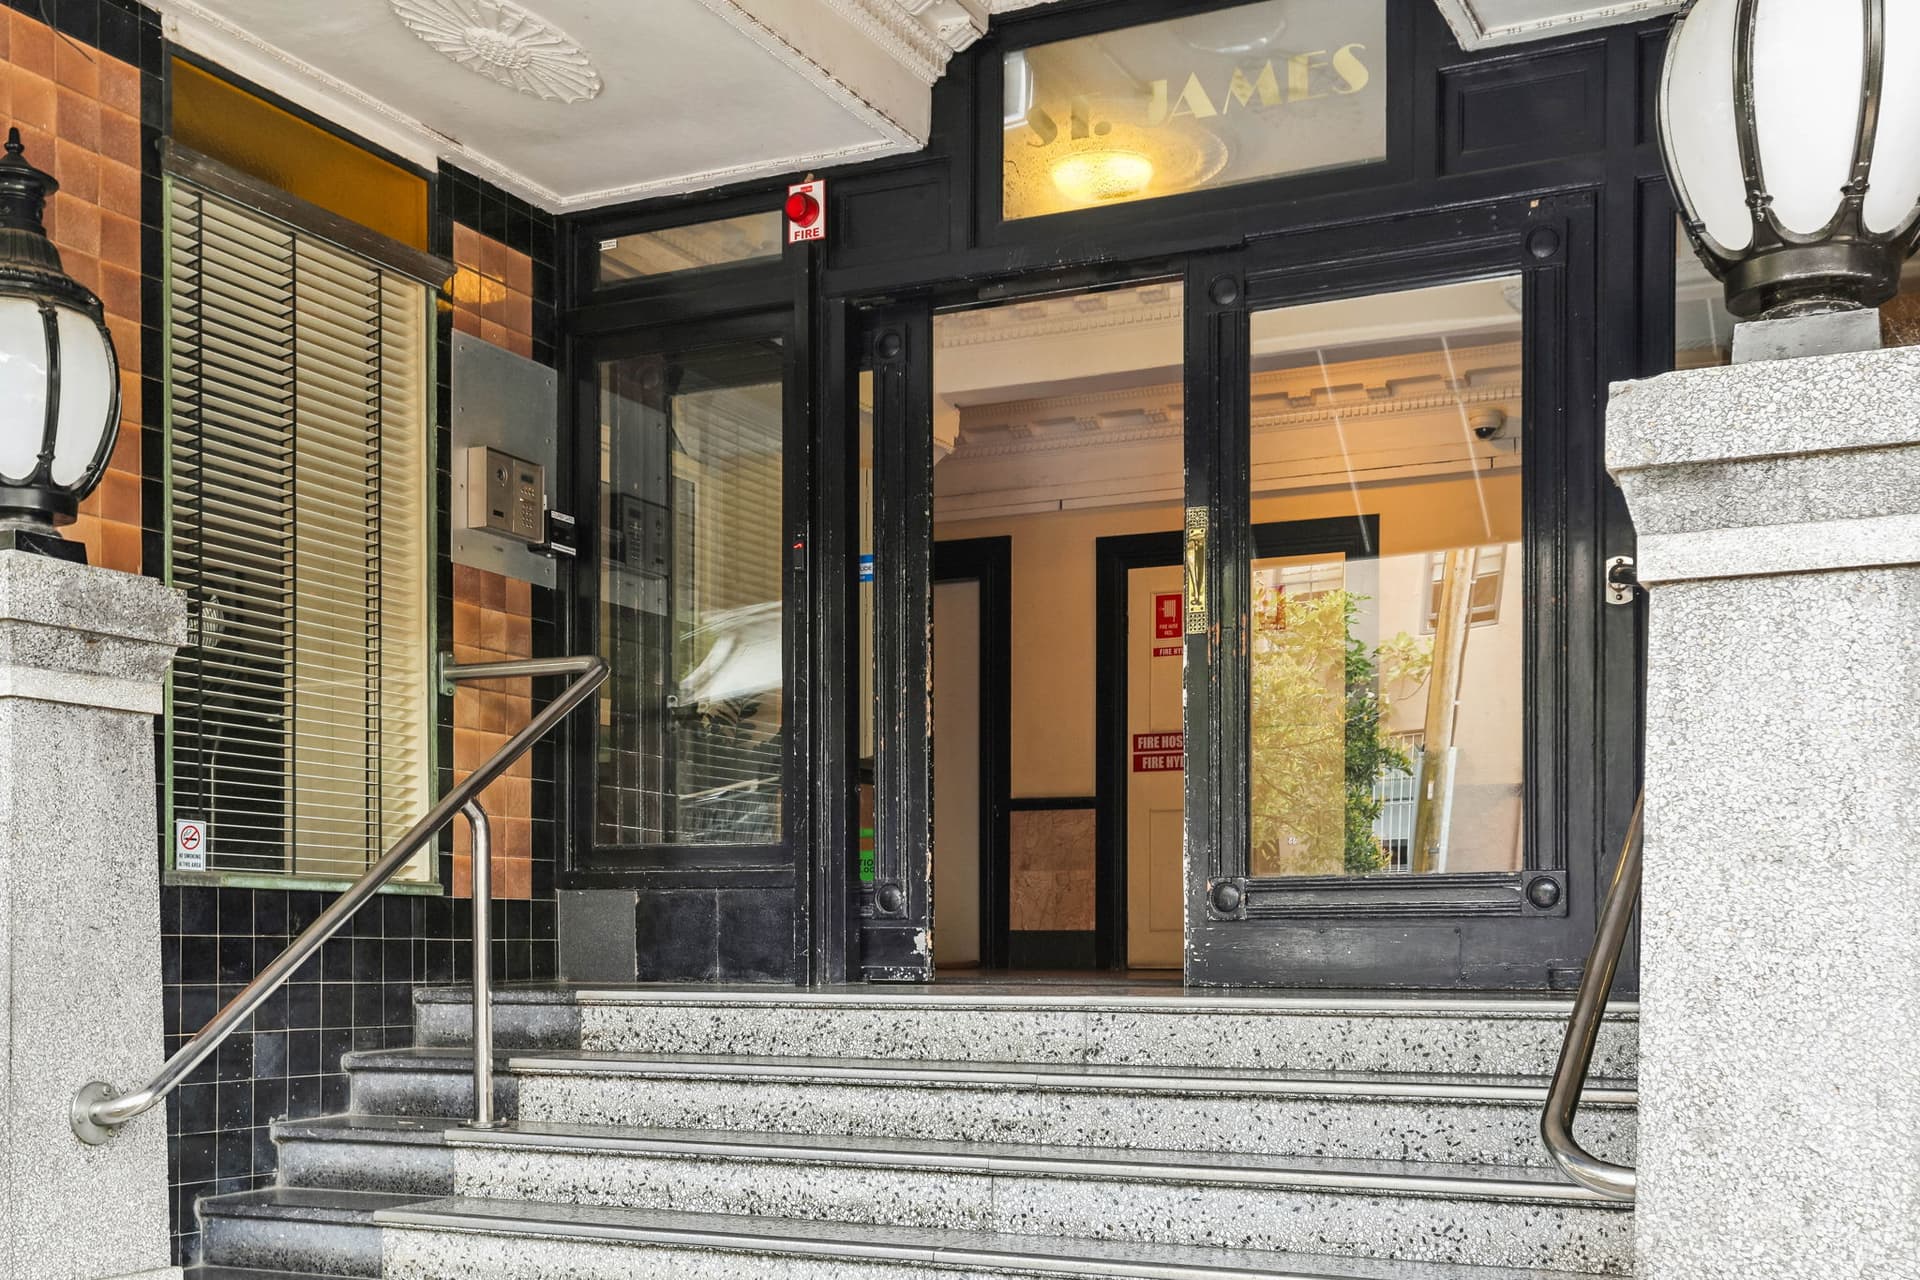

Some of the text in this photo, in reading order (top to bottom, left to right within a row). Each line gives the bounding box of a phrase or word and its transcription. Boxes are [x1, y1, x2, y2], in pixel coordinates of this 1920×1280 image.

[1026, 43, 1369, 148] ST. JAMES
[794, 227, 820, 241] FIRE
[1138, 735, 1183, 749] FIRE HOS
[1142, 756, 1164, 769] FIRE
